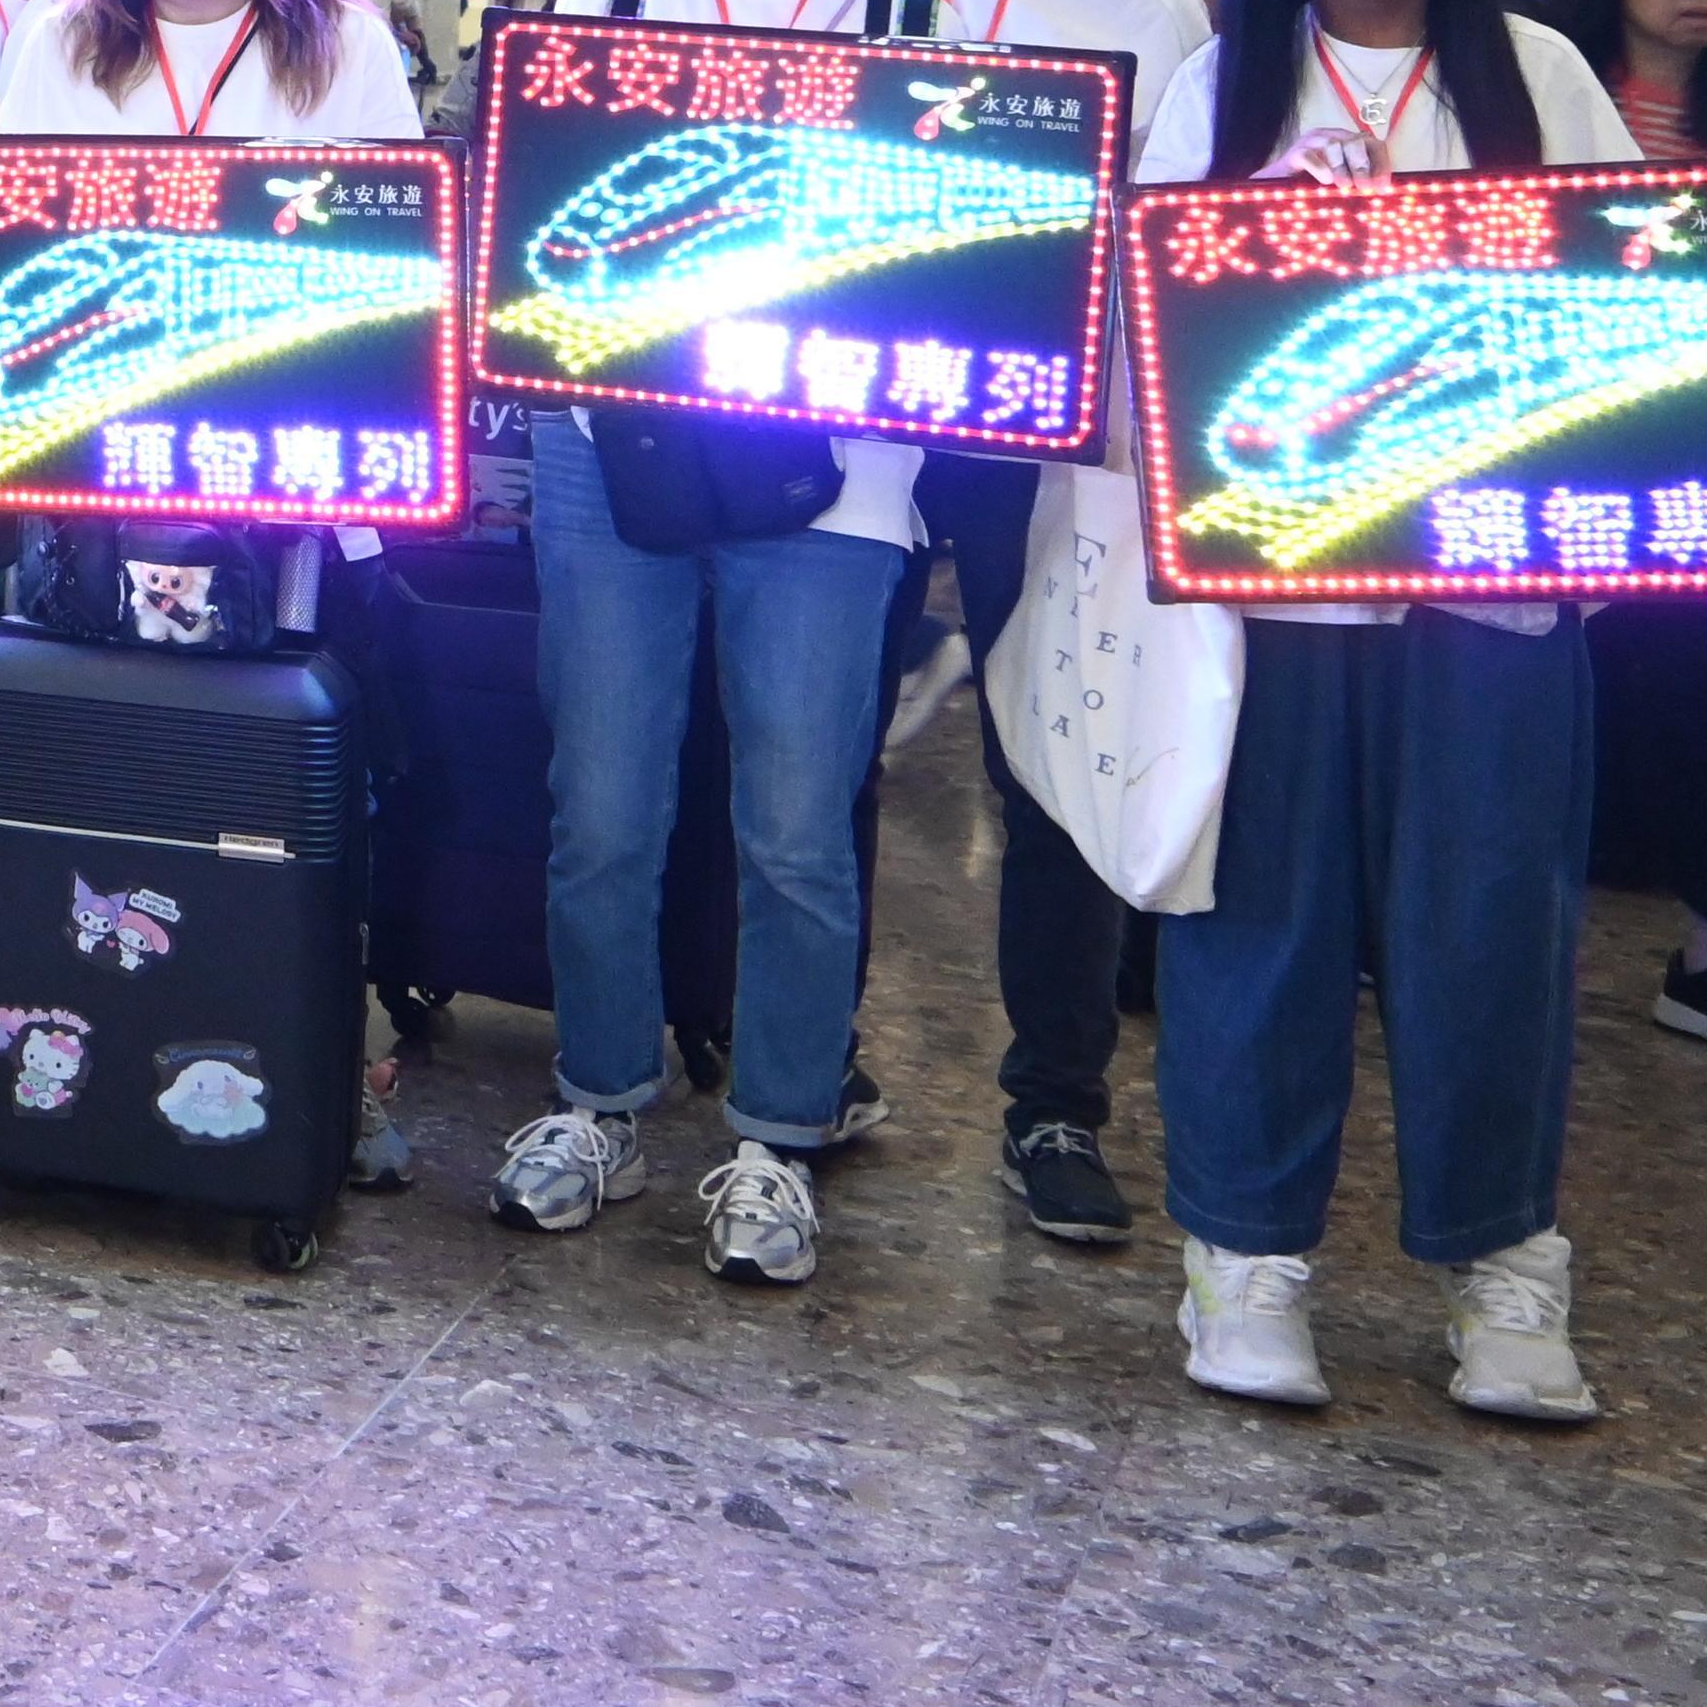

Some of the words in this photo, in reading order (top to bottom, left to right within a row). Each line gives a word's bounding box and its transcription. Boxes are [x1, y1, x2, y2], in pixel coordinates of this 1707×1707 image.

[521, 35, 861, 131] 永安旅遊
[978, 92, 1082, 121] 永安旅遊
[976, 115, 1010, 128] WING
[1015, 119, 1035, 130] ON
[1040, 120, 1080, 133] TRAVEL
[329, 184, 423, 206] 永安旅遊
[329, 206, 359, 216] WING
[364, 207, 381, 216] ON
[387, 208, 423, 218] TRAVEL
[1167, 189, 1560, 285] 永安旅遊
[702, 319, 1071, 430] 輝智專列
[101, 420, 431, 504] 輝智專列
[132, 898, 144, 906] MY
[145, 902, 177, 919] MELODY
[141, 891, 173, 909] KUROMI
